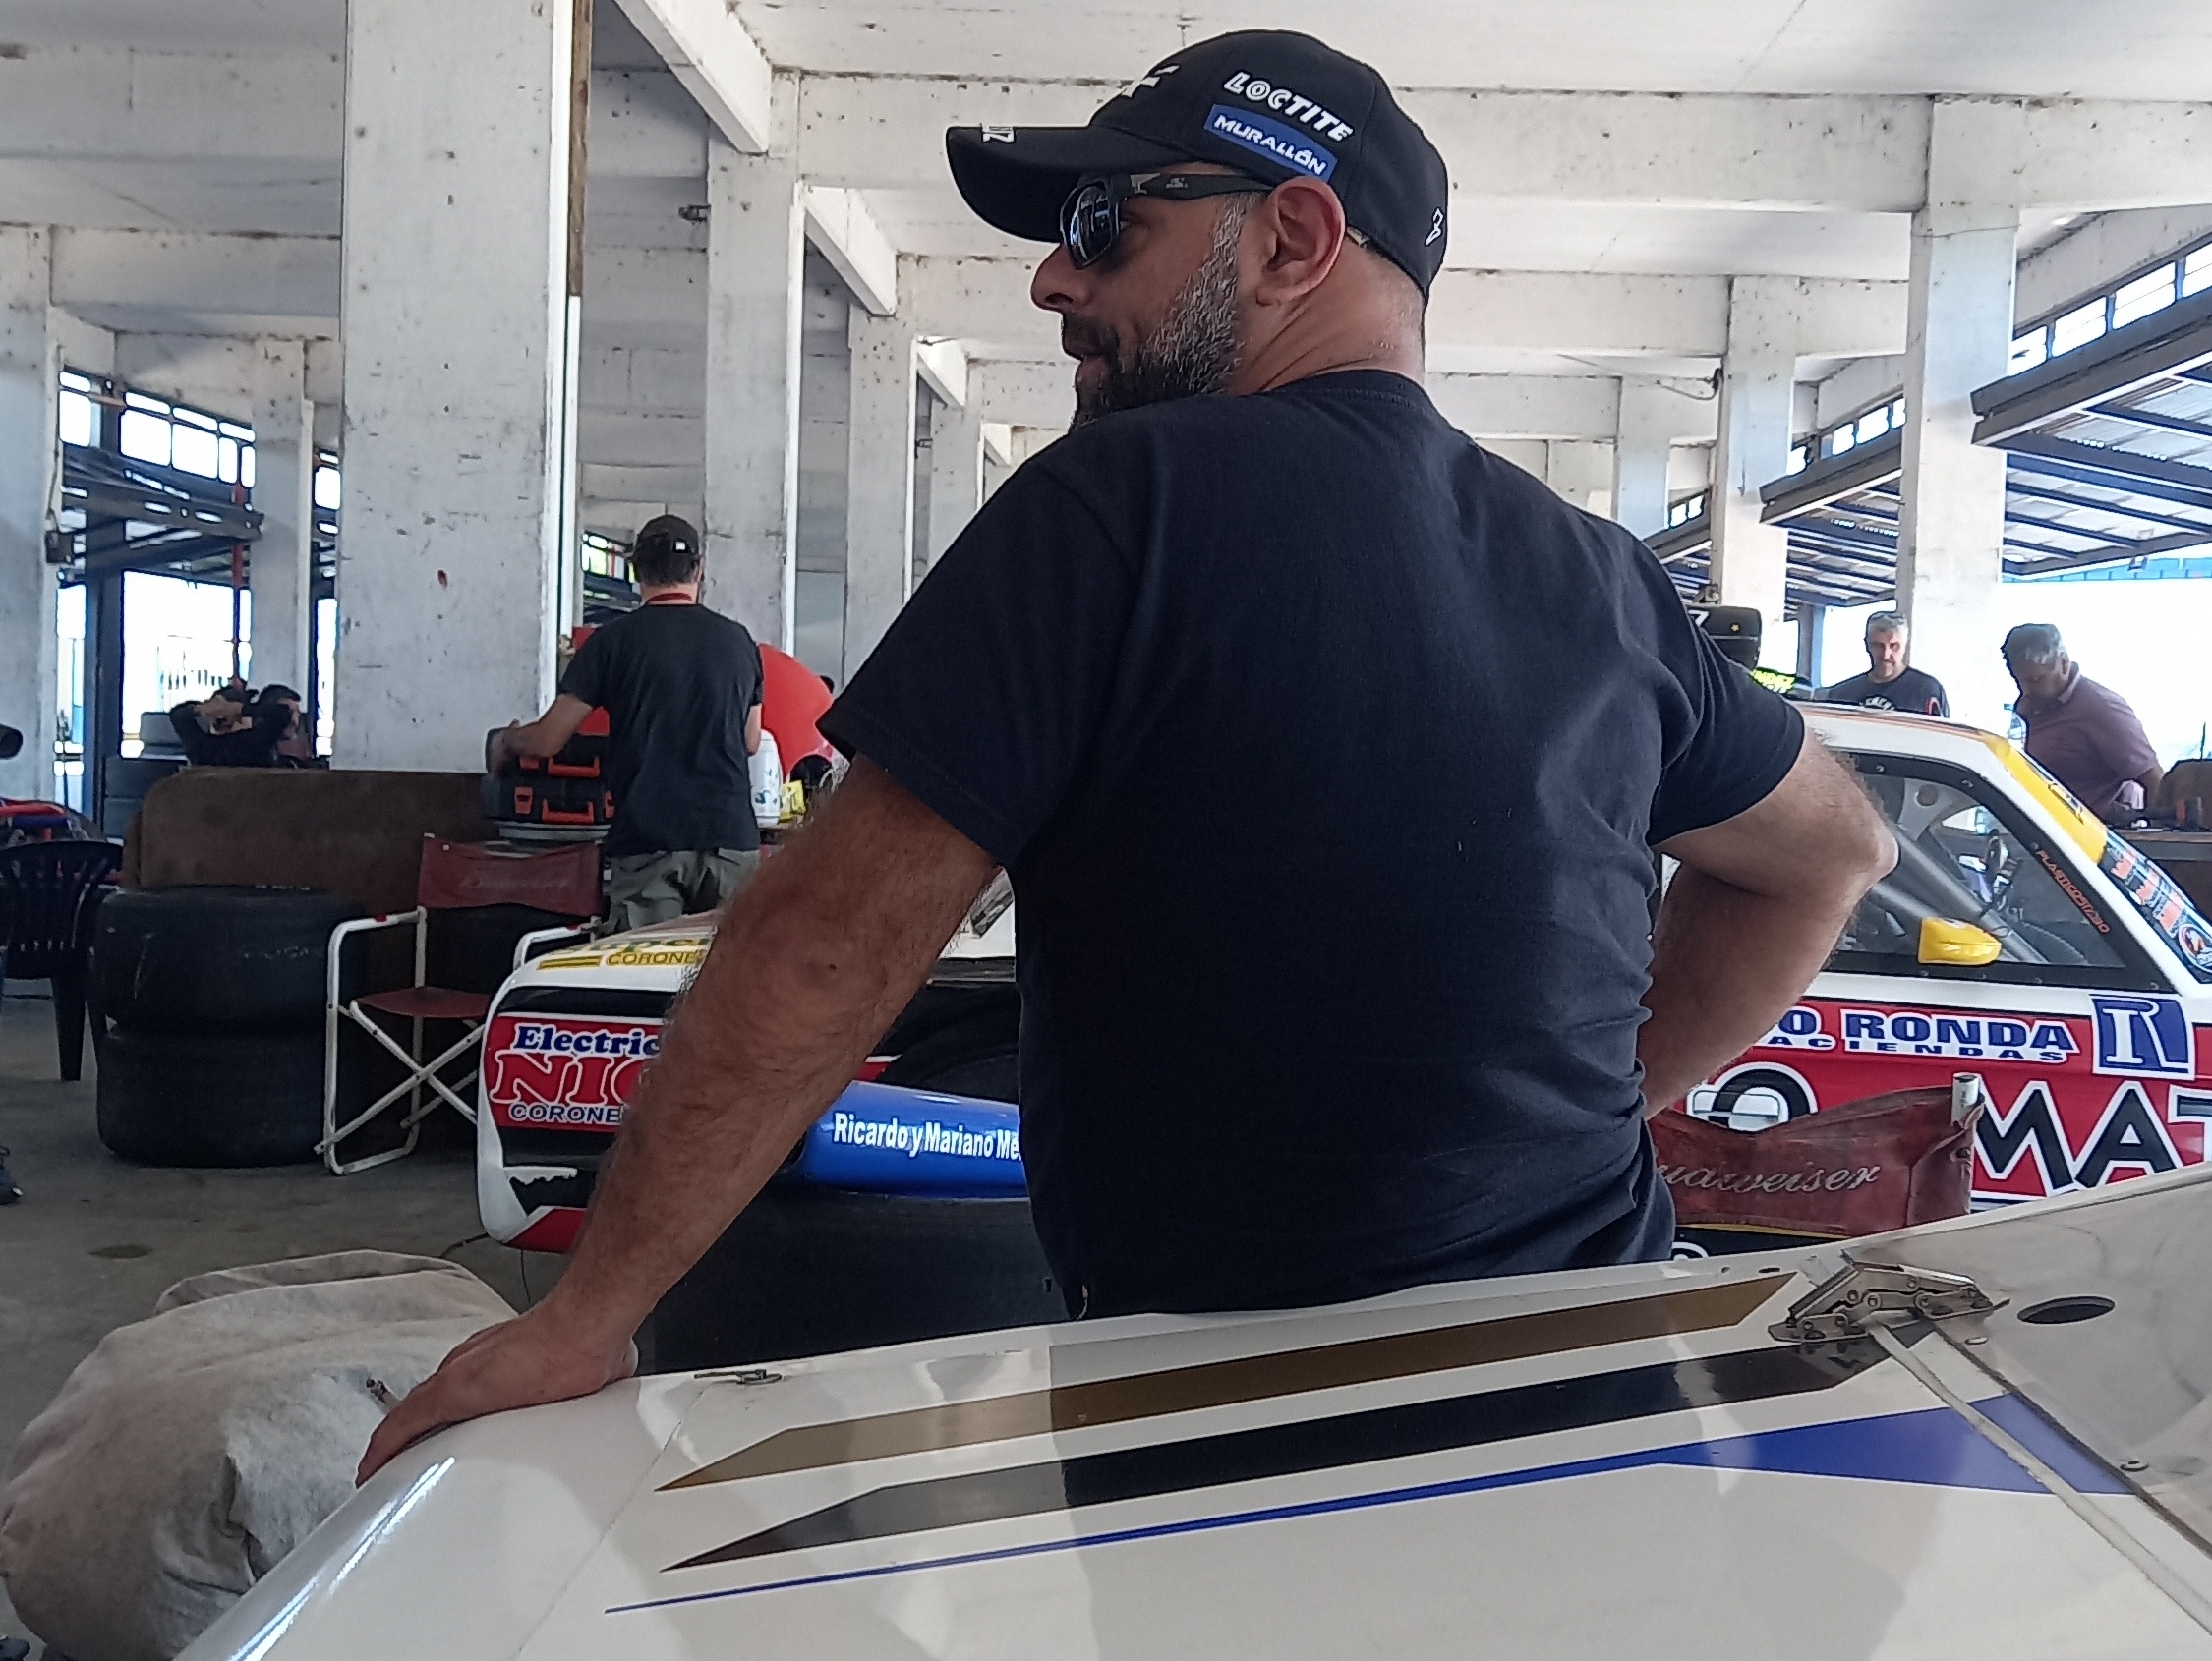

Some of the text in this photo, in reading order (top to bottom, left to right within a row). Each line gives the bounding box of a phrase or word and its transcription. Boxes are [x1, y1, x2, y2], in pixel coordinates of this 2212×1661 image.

[1223, 71, 1354, 142] LOCTITE
[605, 950, 704, 967] CORONE
[1767, 1035, 2065, 1062] ACIENDAS
[1843, 1013, 2075, 1051] RONDA
[509, 1103, 626, 1124] CORONE
[833, 1112, 1022, 1162] Ricardo y Mariano Me
[1656, 1161, 1882, 1194] udweiser
